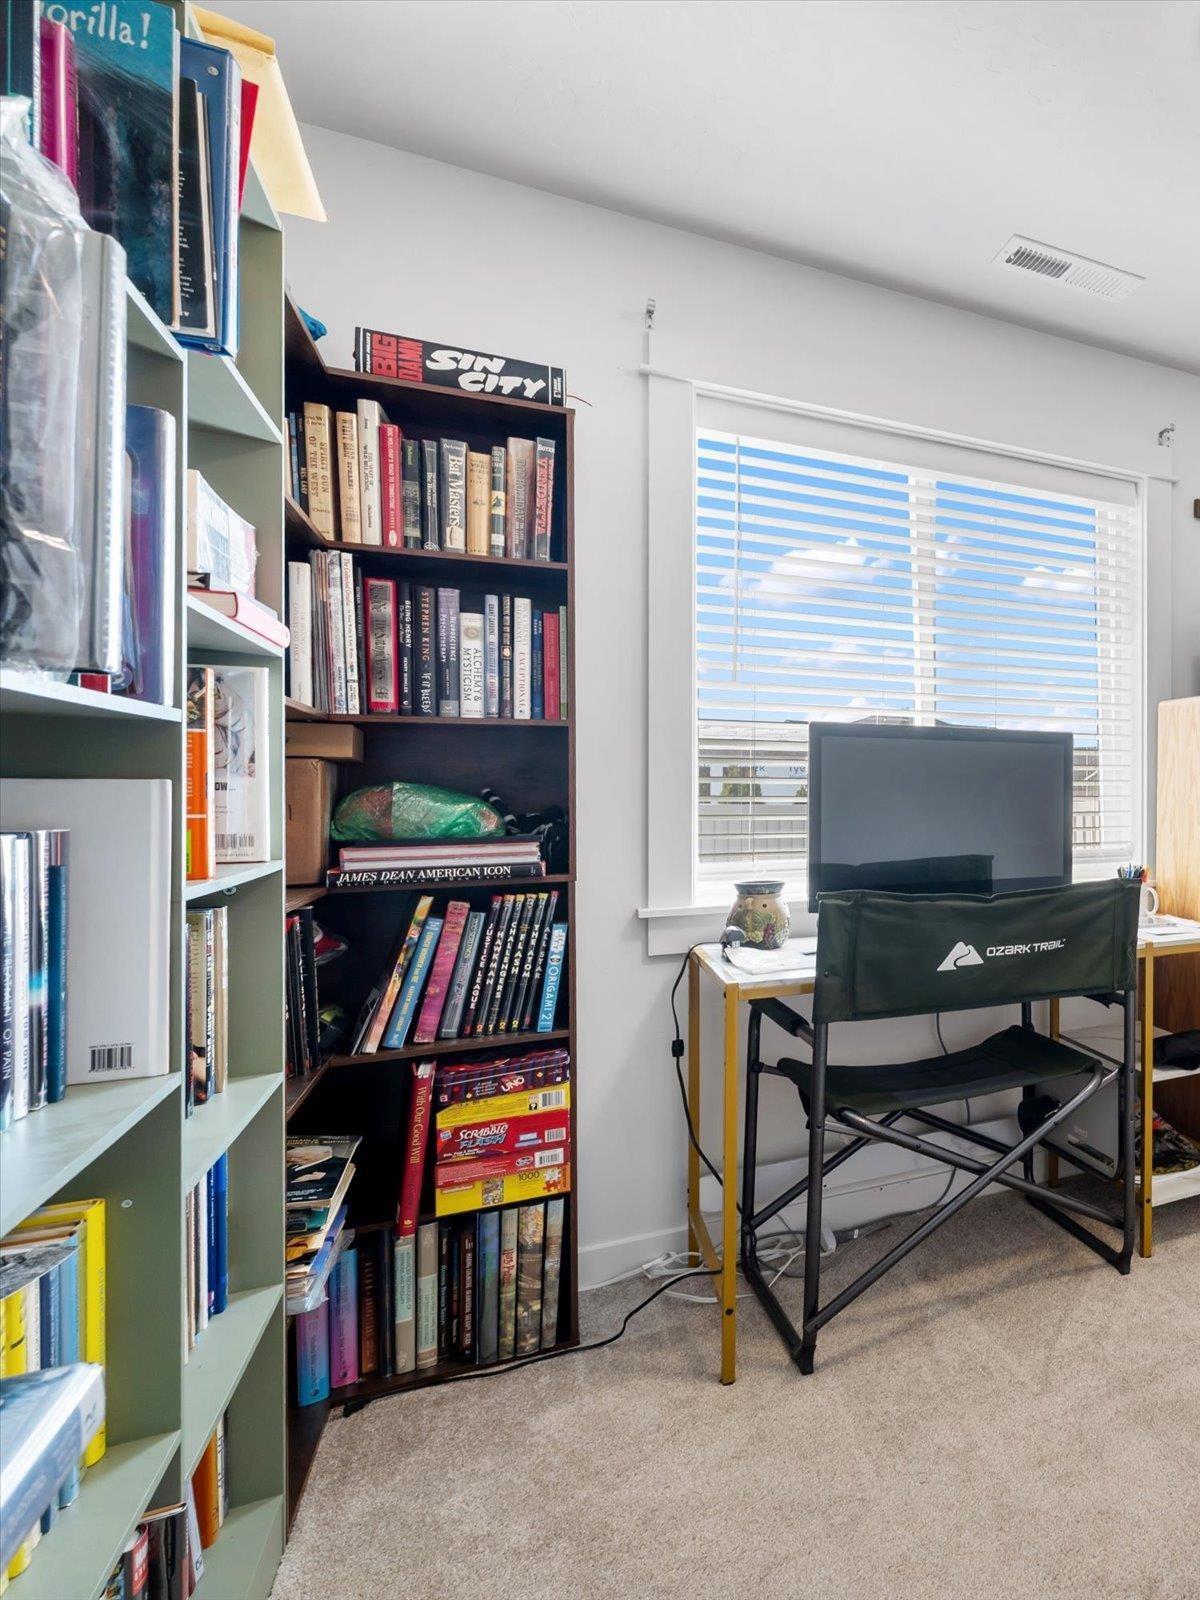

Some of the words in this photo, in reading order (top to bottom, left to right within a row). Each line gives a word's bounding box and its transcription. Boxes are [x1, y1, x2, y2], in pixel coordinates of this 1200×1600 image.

[40, 0, 151, 50] orilla!
[372, 333, 398, 378] BIG
[398, 338, 423, 383] DAMN
[426, 350, 506, 373] SIN
[458, 372, 546, 399] CITY
[309, 436, 316, 447] OF
[310, 451, 318, 469] THE
[320, 442, 329, 472] SPIRIT
[448, 456, 463, 475] Bat
[321, 475, 329, 493] GUN
[448, 478, 464, 527] Masters
[515, 479, 526, 520] HOLLIDAY
[421, 591, 429, 633] STEPHEN
[421, 637, 430, 662] KING
[463, 647, 472, 702] MYSTICISM
[473, 648, 482, 694] ALCHEMY
[518, 651, 526, 708] EXCEPTIONAL
[421, 689, 432, 714] BLEEDS
[215, 782, 236, 791] OW...
[337, 872, 377, 884] JAMES
[380, 870, 415, 881] DEAN
[418, 867, 480, 879] AMERICAN
[484, 866, 512, 876] ICON
[480, 923, 493, 968] JUSTICE
[531, 925, 539, 945] THE
[986, 943, 1032, 957] OZARK
[1033, 939, 1066, 952] TRAIL
[486, 931, 504, 985] HAWKMAN
[495, 921, 517, 999] CHALLENGERS
[511, 933, 526, 974] FLASH
[522, 950, 534, 978] ATOM
[534, 952, 545, 978] STAR
[470, 970, 482, 1009] LEAGUE
[545, 966, 559, 1011] ORIGAMI
[3, 1028, 11, 1046] OF
[3, 1051, 12, 1080] PAIN
[416, 1086, 427, 1106] With
[502, 1075, 524, 1092] UNO
[414, 1107, 425, 1124] Our
[411, 1124, 423, 1146] Good
[410, 1147, 420, 1164] Will
[518, 1171, 540, 1181] 1000
